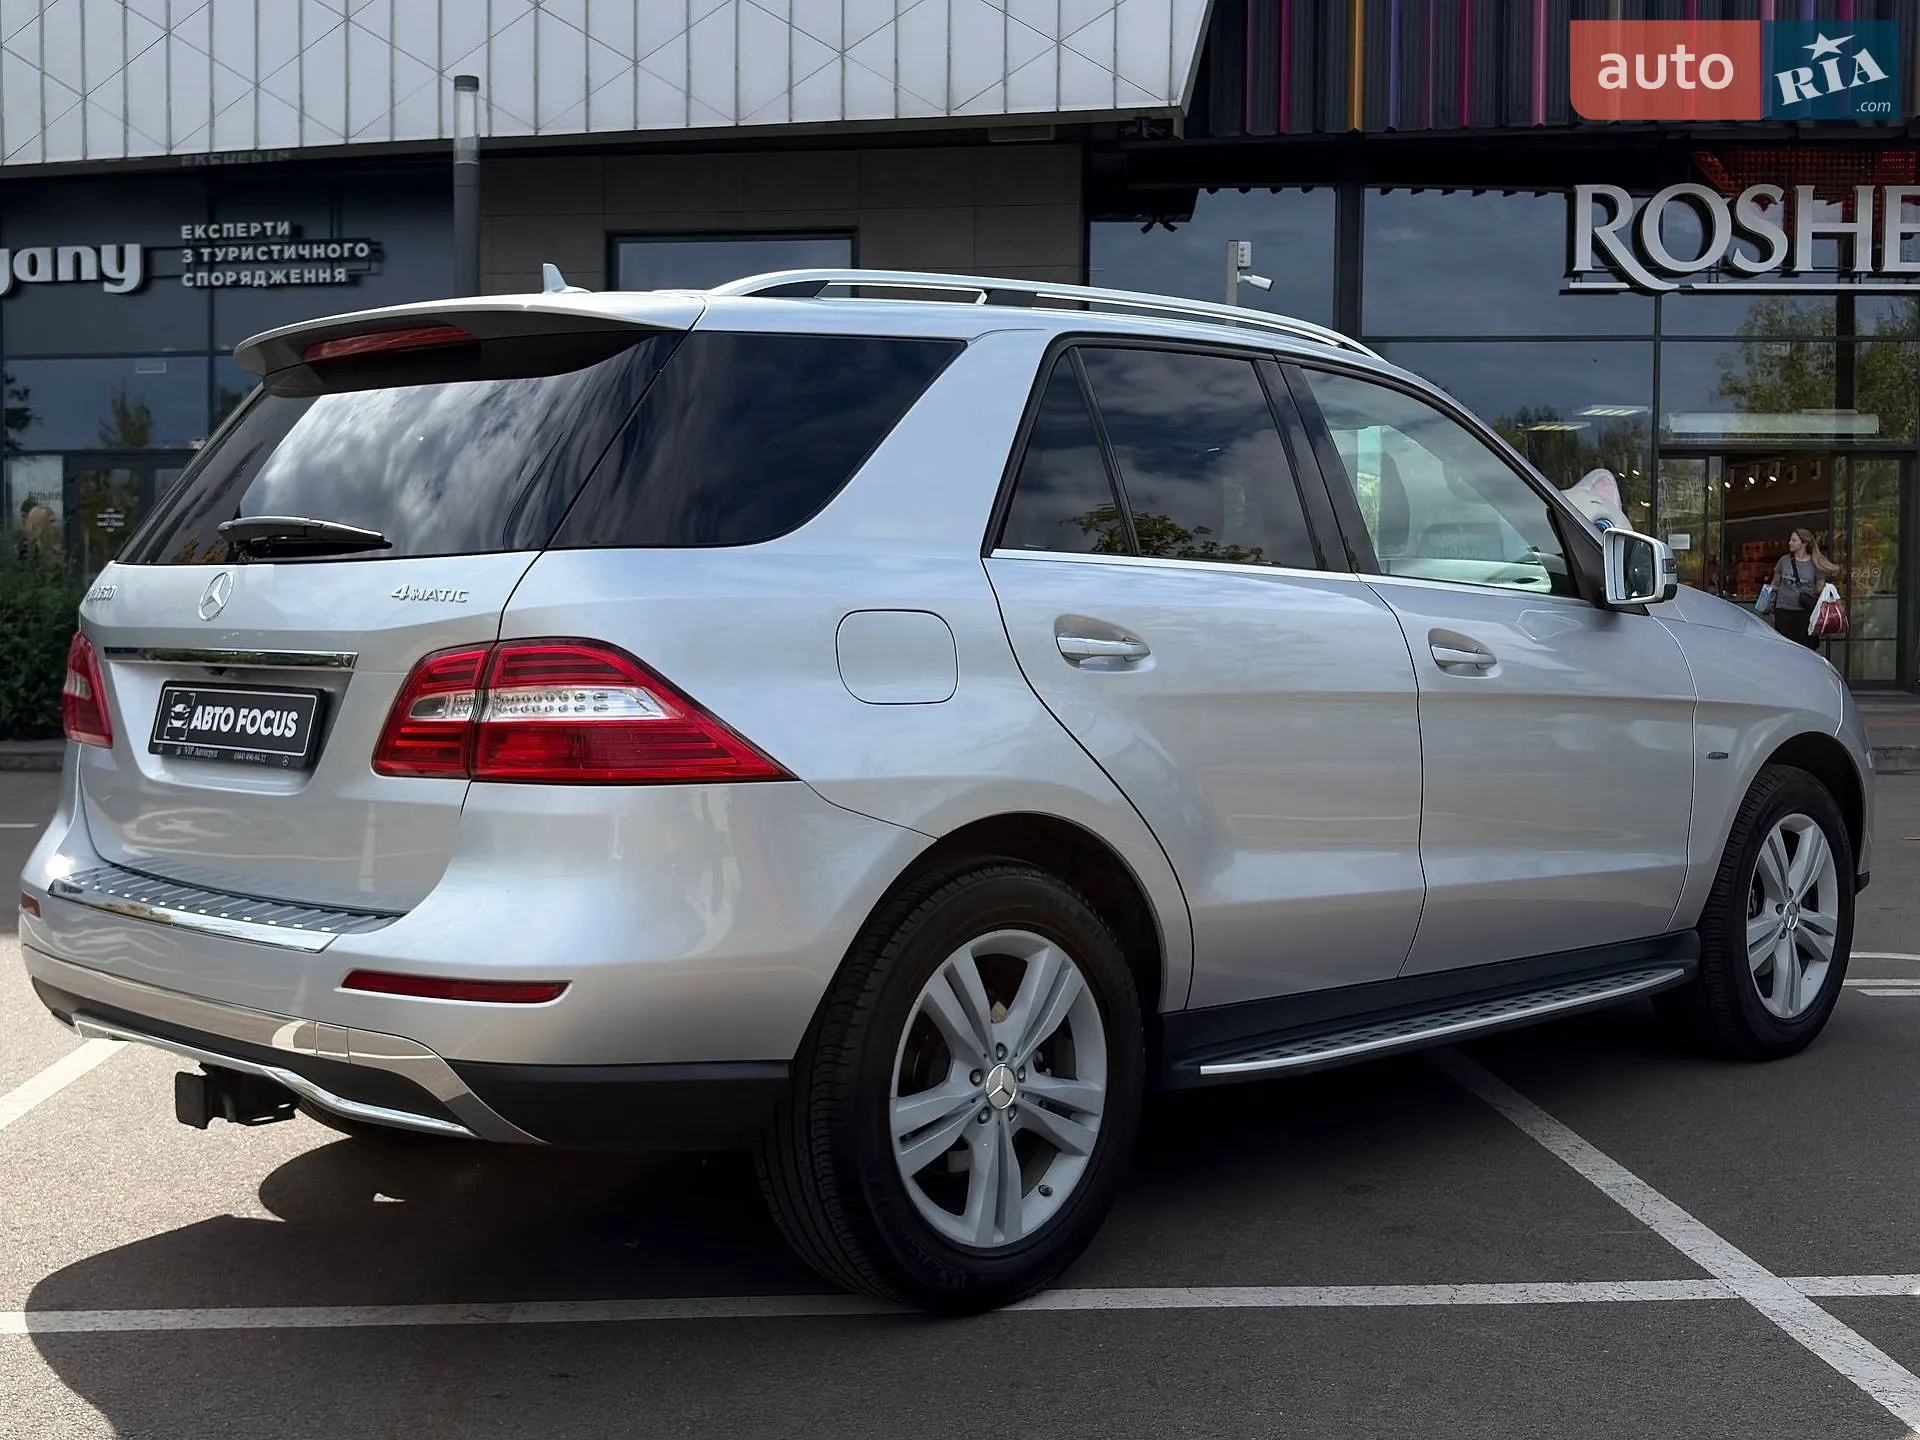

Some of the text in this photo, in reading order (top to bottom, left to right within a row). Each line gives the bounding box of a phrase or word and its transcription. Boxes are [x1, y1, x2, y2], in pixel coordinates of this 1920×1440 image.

[180, 221, 291, 240] ЕКСПЕРТИ
[1572, 182, 1920, 291] ROSHE
[200, 242, 370, 263] ТУРИСТИЧНОГО
[0, 243, 142, 296] any
[181, 268, 348, 288] СПОРЯДЖЕННЯ
[391, 583, 470, 603] 4MATIC
[190, 705, 299, 738] АВТО FOCUS
